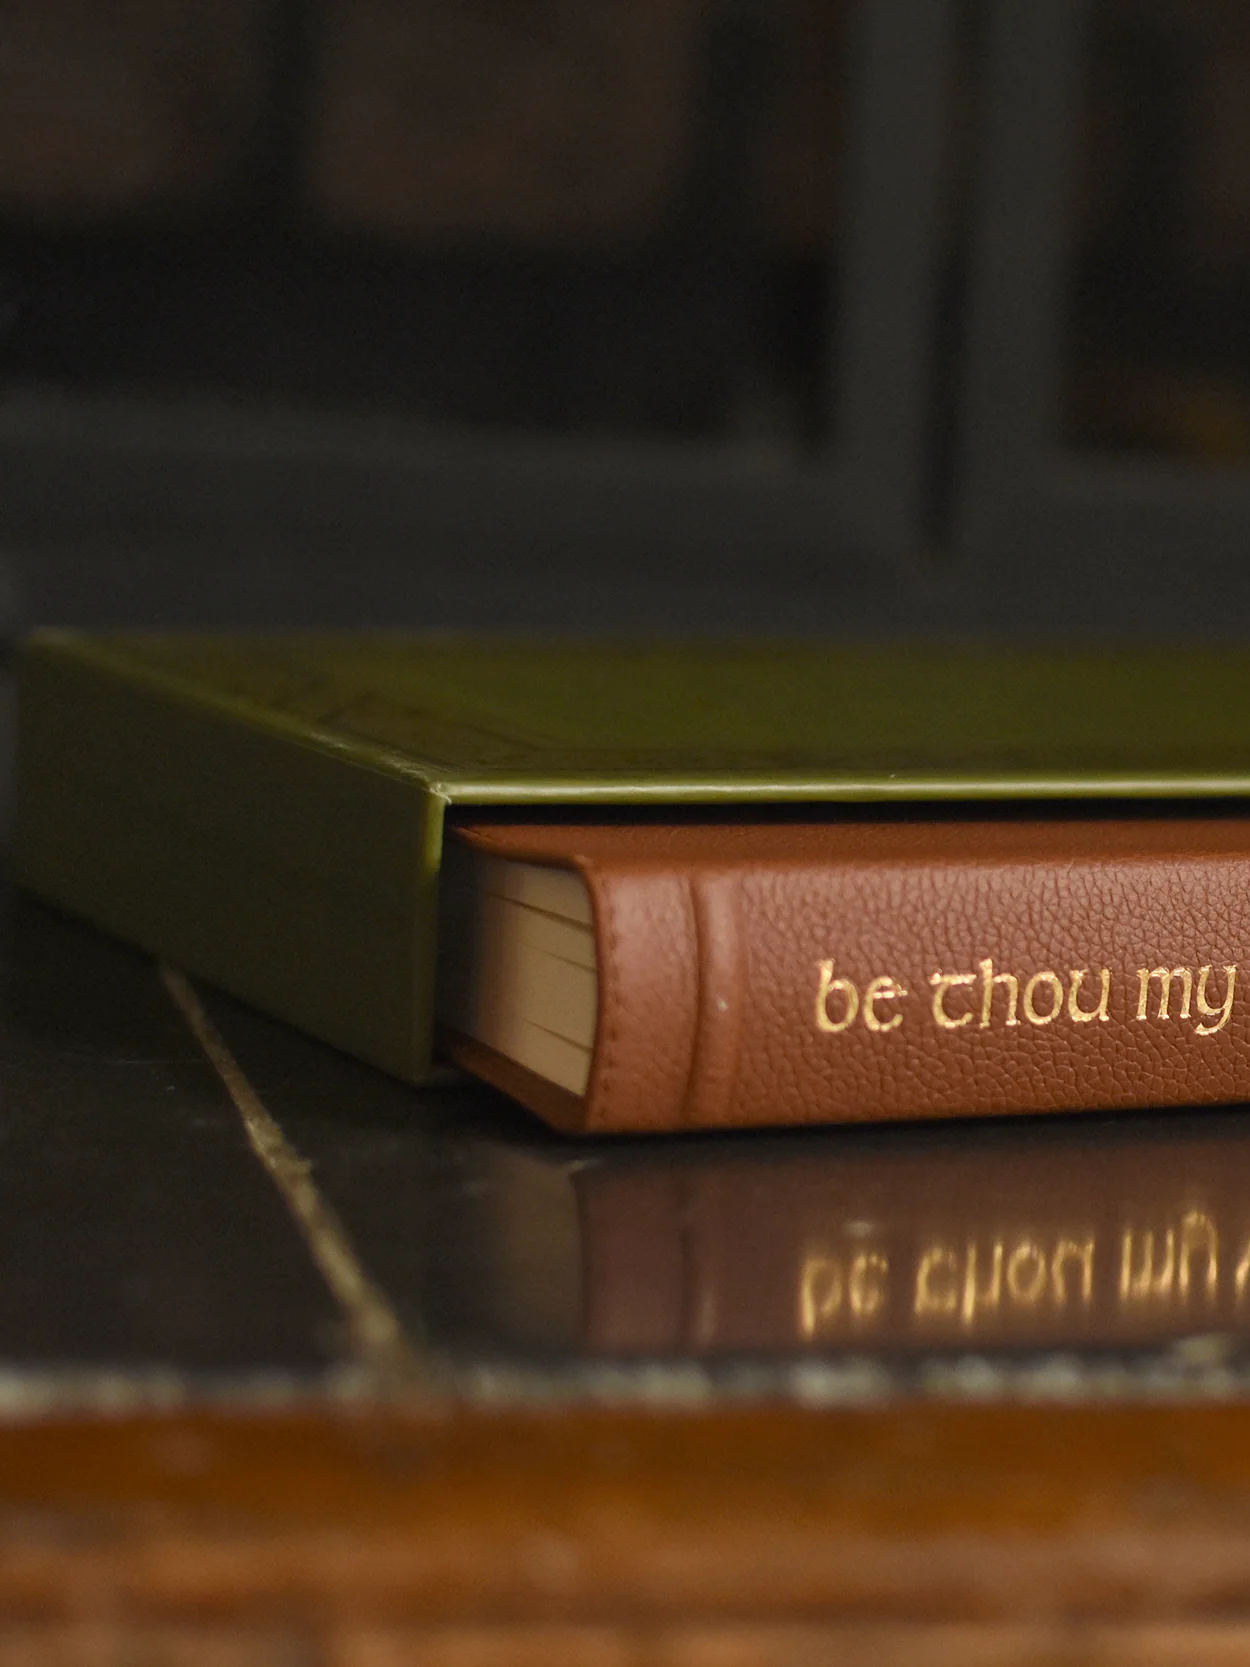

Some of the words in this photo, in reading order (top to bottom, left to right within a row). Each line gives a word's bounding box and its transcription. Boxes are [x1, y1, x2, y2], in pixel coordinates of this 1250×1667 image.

[815, 957, 908, 1033] be
[929, 957, 1112, 1029] thou
[1134, 963, 1238, 1036] my
